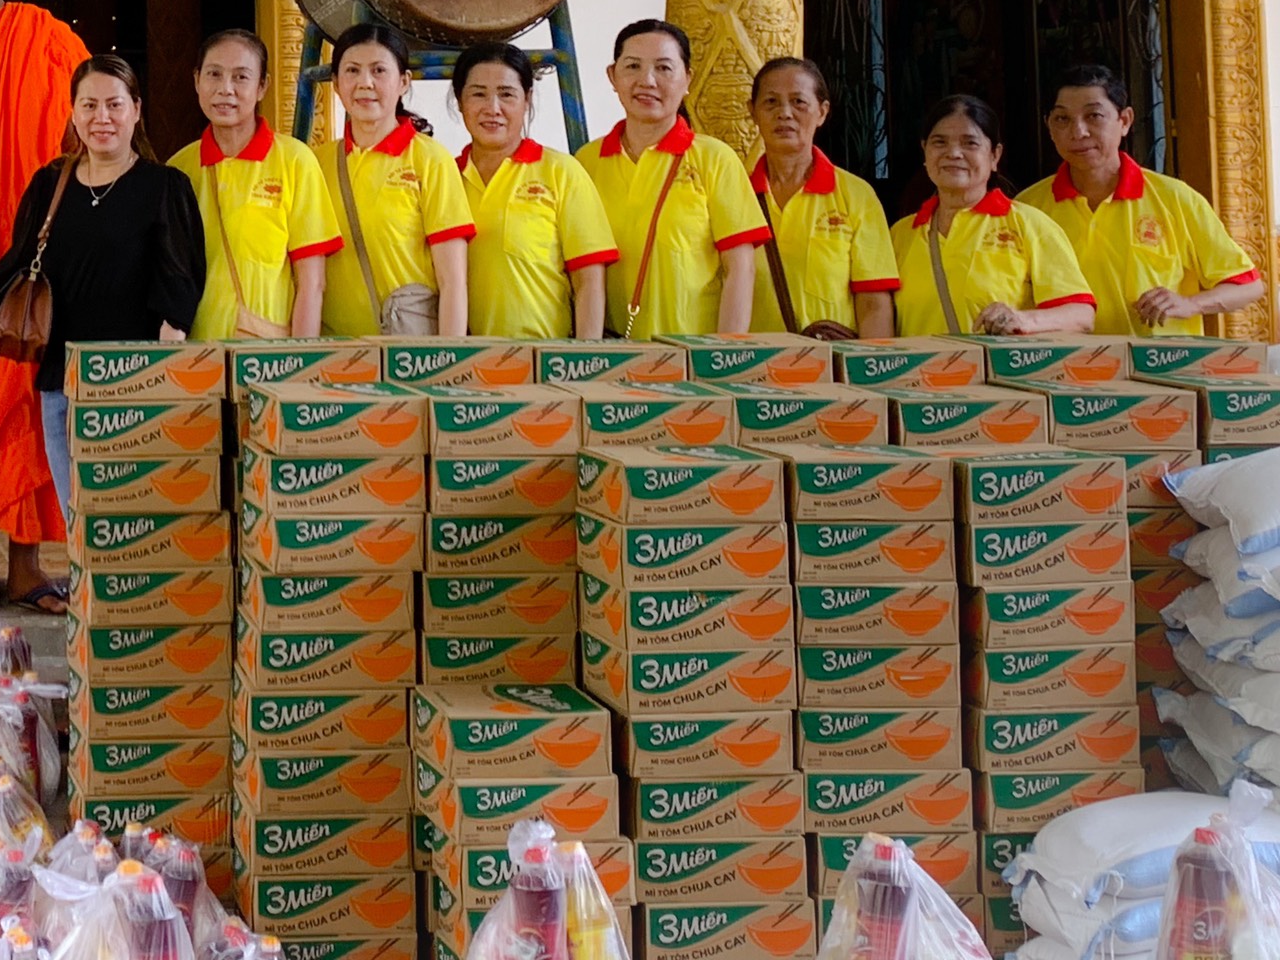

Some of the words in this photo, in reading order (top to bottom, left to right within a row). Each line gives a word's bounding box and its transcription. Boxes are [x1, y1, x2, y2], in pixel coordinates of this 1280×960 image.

[118, 382, 145, 396] CHUA
[147, 374, 166, 387] CAY
[112, 438, 140, 452] CHUA
[142, 429, 162, 443] CAY
[309, 493, 338, 508] CHUA
[340, 484, 361, 499] CAY
[1011, 502, 1040, 517] CHUA
[1043, 492, 1064, 508] CAY
[668, 564, 698, 580] CHUA
[700, 555, 722, 570] CAY
[1014, 563, 1043, 577] CHUA
[1045, 552, 1065, 567] CAY
[301, 669, 330, 683] CHUA
[332, 660, 353, 674] CAY
[672, 690, 704, 706] CHUA
[705, 681, 727, 696] CAY
[291, 732, 321, 746] CHUA
[322, 722, 343, 737] CAY
[1024, 750, 1054, 764] CHUA
[1056, 740, 1078, 755] CAY
[682, 820, 713, 836] CHUA
[715, 810, 737, 826] CAY
[849, 810, 880, 825] CHUA
[882, 802, 904, 818] CAY
[295, 857, 325, 871] CHUA
[327, 846, 348, 861] CAY
